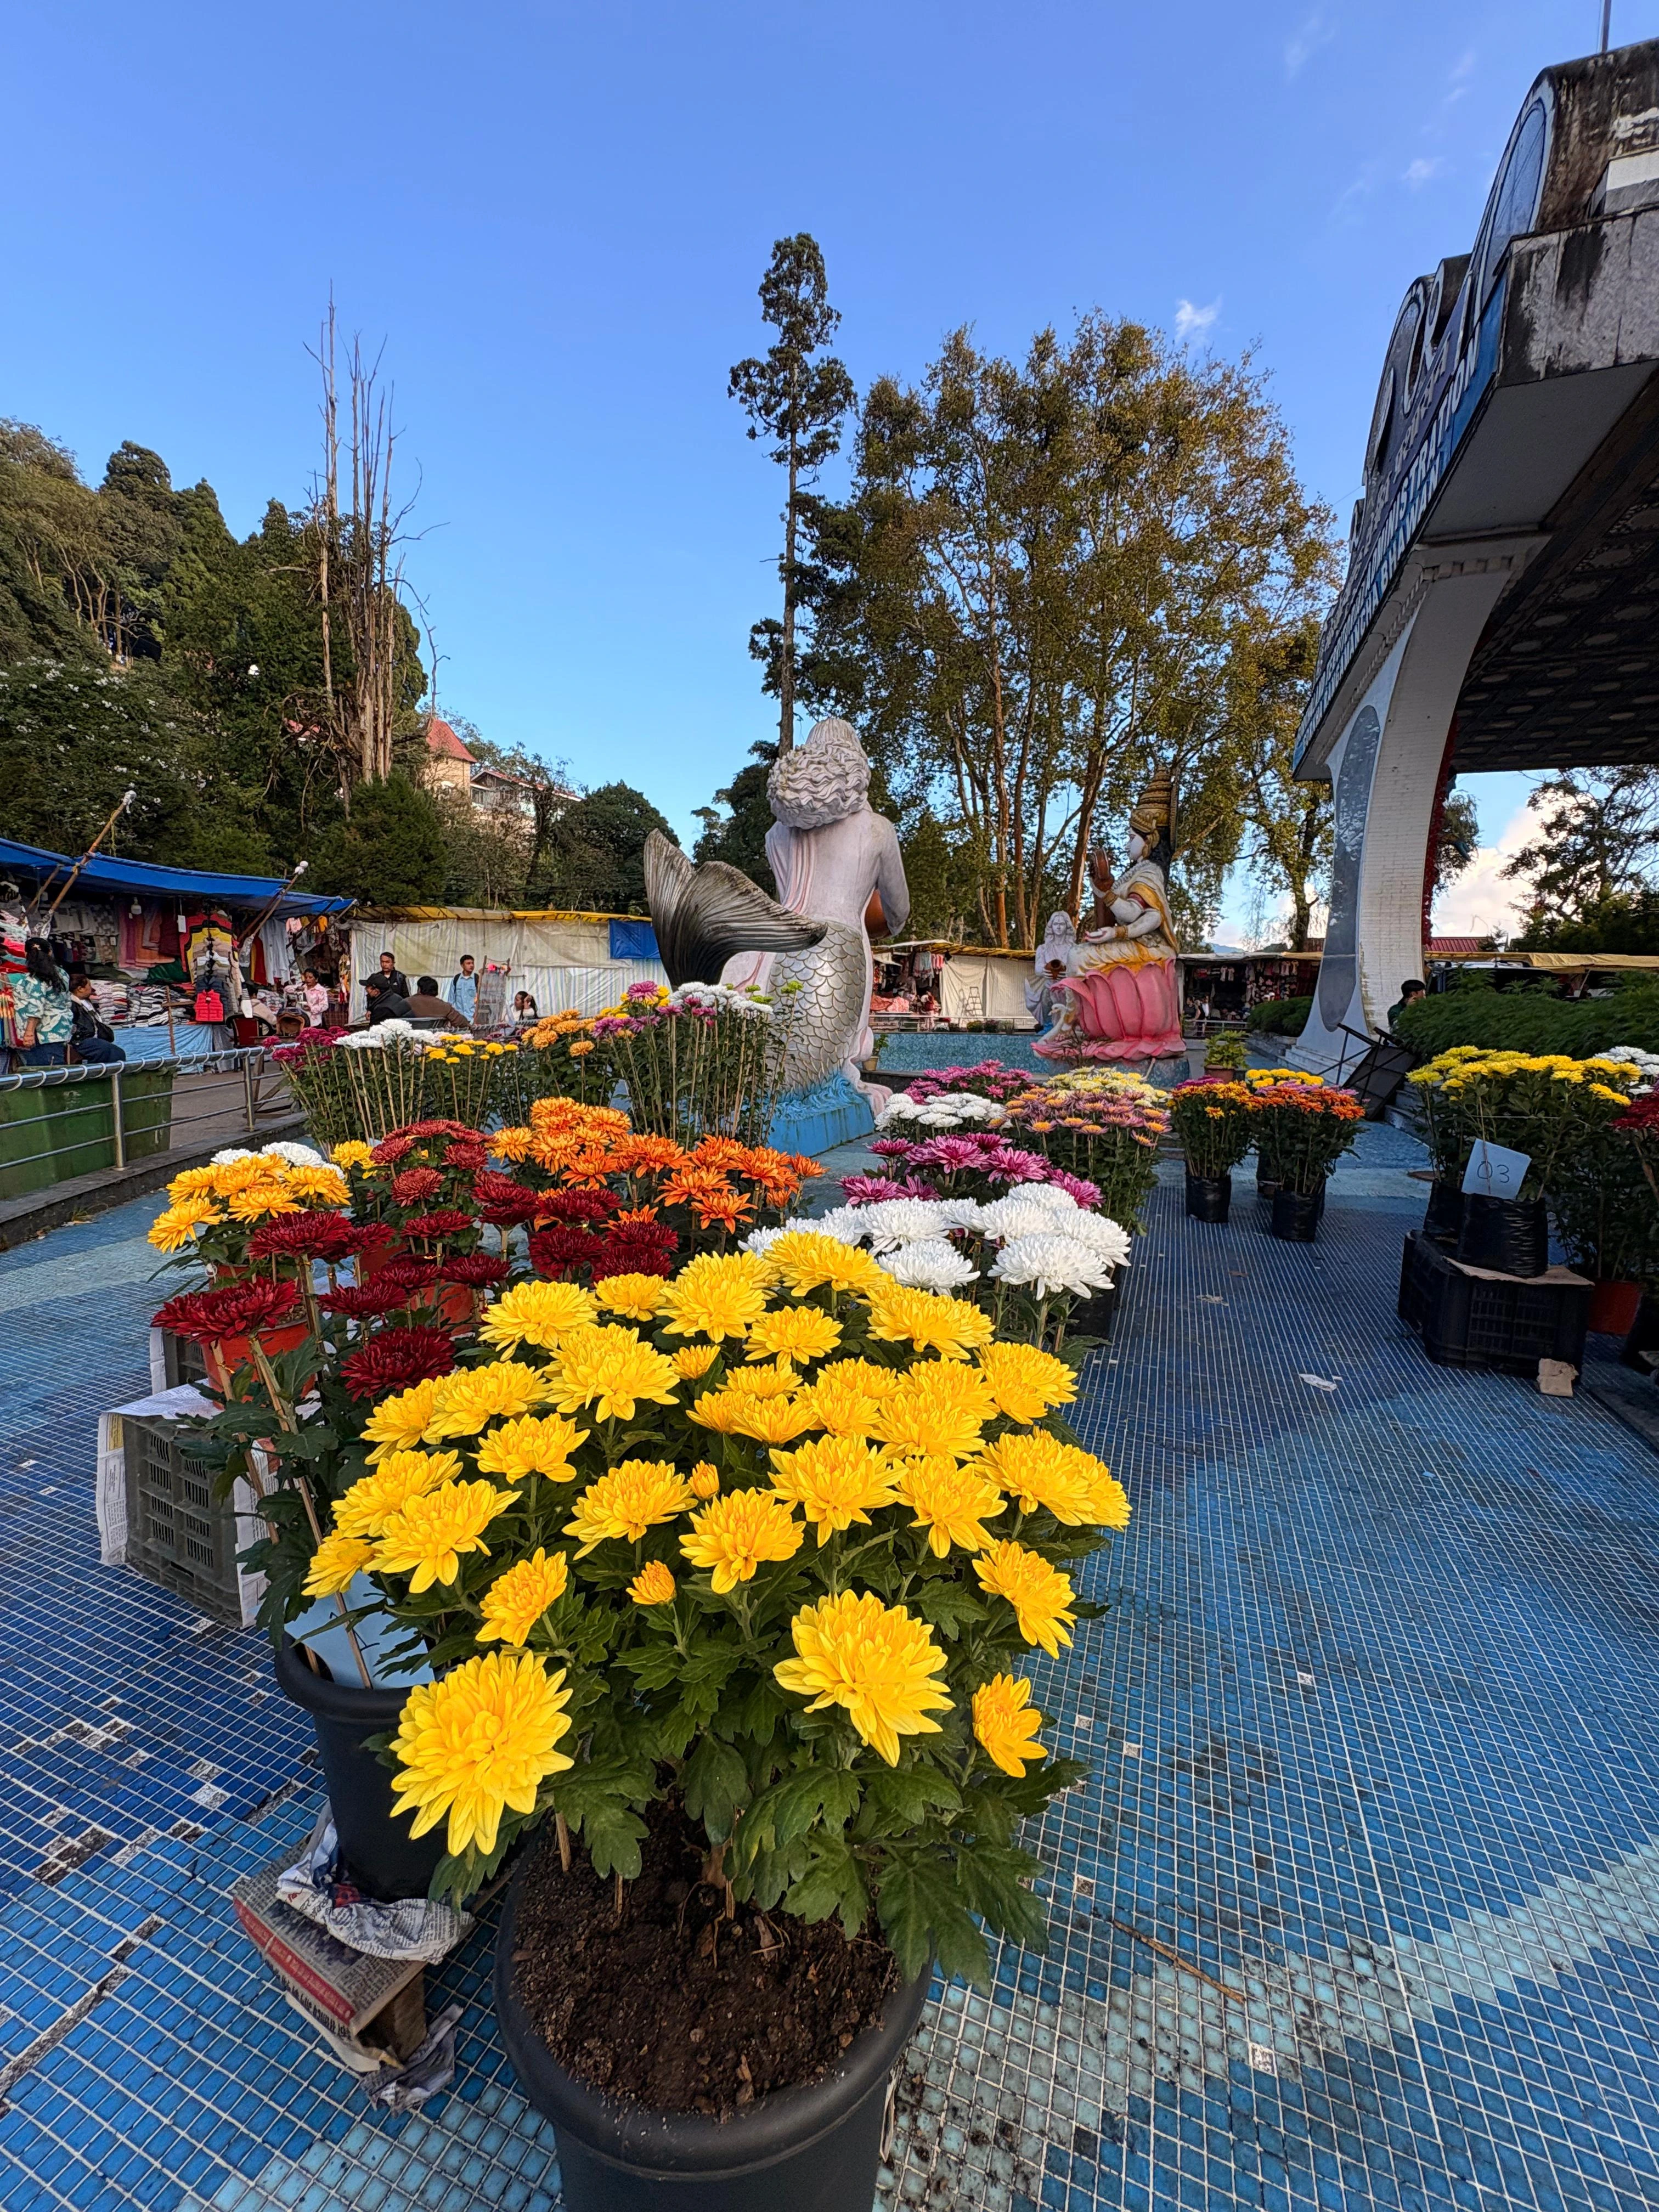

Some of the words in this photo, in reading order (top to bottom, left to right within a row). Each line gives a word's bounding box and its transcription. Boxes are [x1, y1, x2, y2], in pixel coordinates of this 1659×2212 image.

[1325, 577, 1366, 687] TERRITORIAL
[1365, 320, 1480, 596] ADMINISTRATION
[1381, 449, 1441, 595] BHAWAN
[1477, 1160, 1510, 1183] 03
